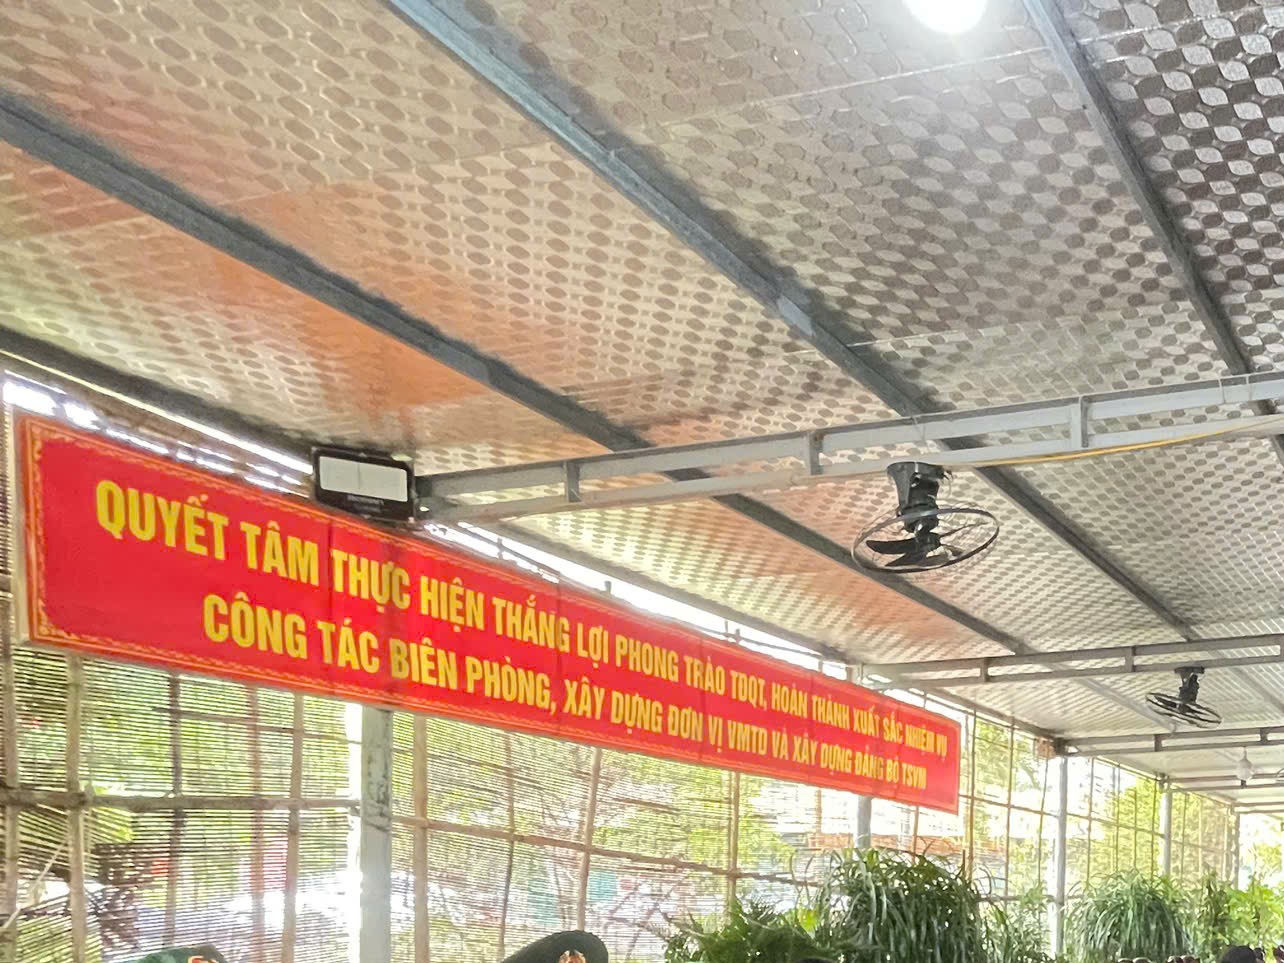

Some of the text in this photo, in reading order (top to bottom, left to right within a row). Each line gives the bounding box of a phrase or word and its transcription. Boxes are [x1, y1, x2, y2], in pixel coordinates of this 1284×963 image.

[95, 480, 228, 560] QUYẾT
[239, 520, 320, 586] TÂM
[331, 549, 410, 613] THỰC
[420, 576, 485, 634] HIỆN
[492, 594, 570, 653] THẮNG
[577, 622, 609, 669] LỢI
[615, 634, 679, 684] PHONG
[684, 655, 726, 697] TRÀO
[772, 682, 808, 718] HOÀN
[812, 694, 850, 729] THÀNH
[853, 705, 880, 738] XUẤT
[883, 712, 904, 745] SẮC
[905, 724, 935, 756] NHIỆM
[936, 733, 948, 761] VỤ
[204, 591, 307, 659] CÔNG
[317, 619, 380, 674] TÁC
[390, 637, 458, 690] BIÊN
[466, 655, 556, 716] PHÒNG,
[564, 676, 605, 719] XÂY
[611, 691, 663, 735] DỰNG
[667, 703, 704, 741] ĐƠN
[707, 716, 723, 753] VỊ
[727, 718, 768, 756] VMTD
[772, 727, 789, 761] VÀ
[793, 730, 818, 766] XÂY
[820, 743, 853, 776] DỰNG
[854, 745, 884, 780] ĐẢNG
[886, 755, 899, 788] BỘ
